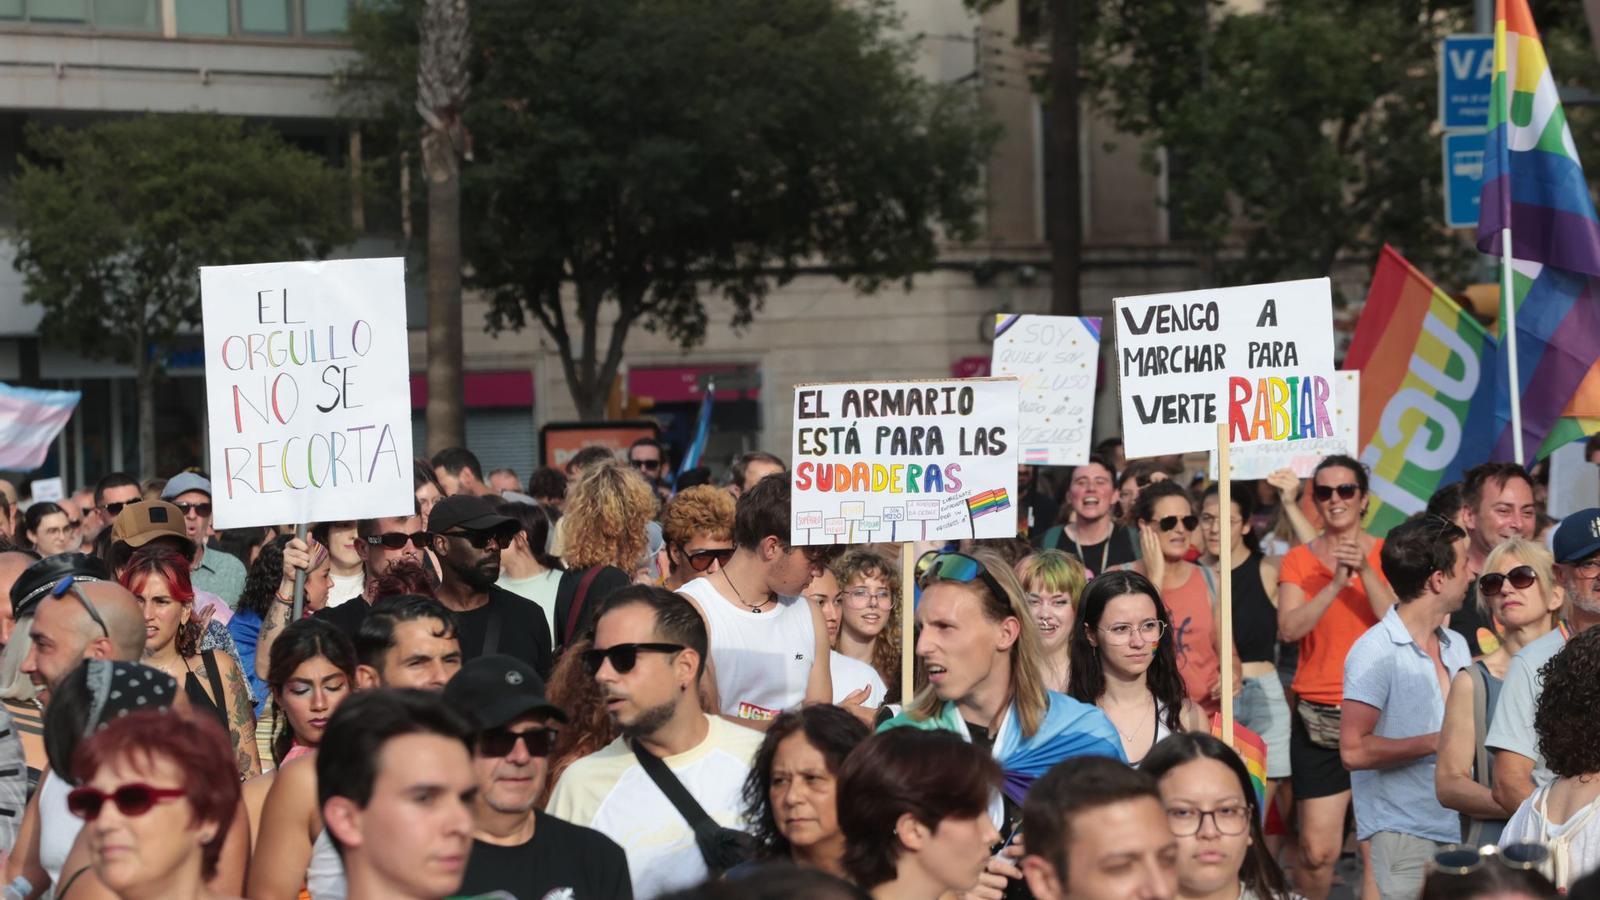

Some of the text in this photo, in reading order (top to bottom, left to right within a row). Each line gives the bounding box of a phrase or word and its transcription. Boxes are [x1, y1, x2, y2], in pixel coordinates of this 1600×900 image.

[258, 288, 306, 324] EL
[1121, 299, 1278, 335] VENGO A
[222, 320, 372, 370] ORGULLO
[1024, 324, 1072, 347] SOY
[1000, 349, 1046, 364] QUIEN
[1123, 341, 1299, 377] MARCHAR PARA
[232, 365, 363, 433] NO SE
[798, 386, 974, 419] EL ARMARIO
[1132, 375, 1334, 443] VERTE RABIAR
[798, 421, 1008, 456] ESTÁ PARA LAS
[224, 424, 401, 499] RECORTA
[795, 461, 963, 494] SUDADERAS
